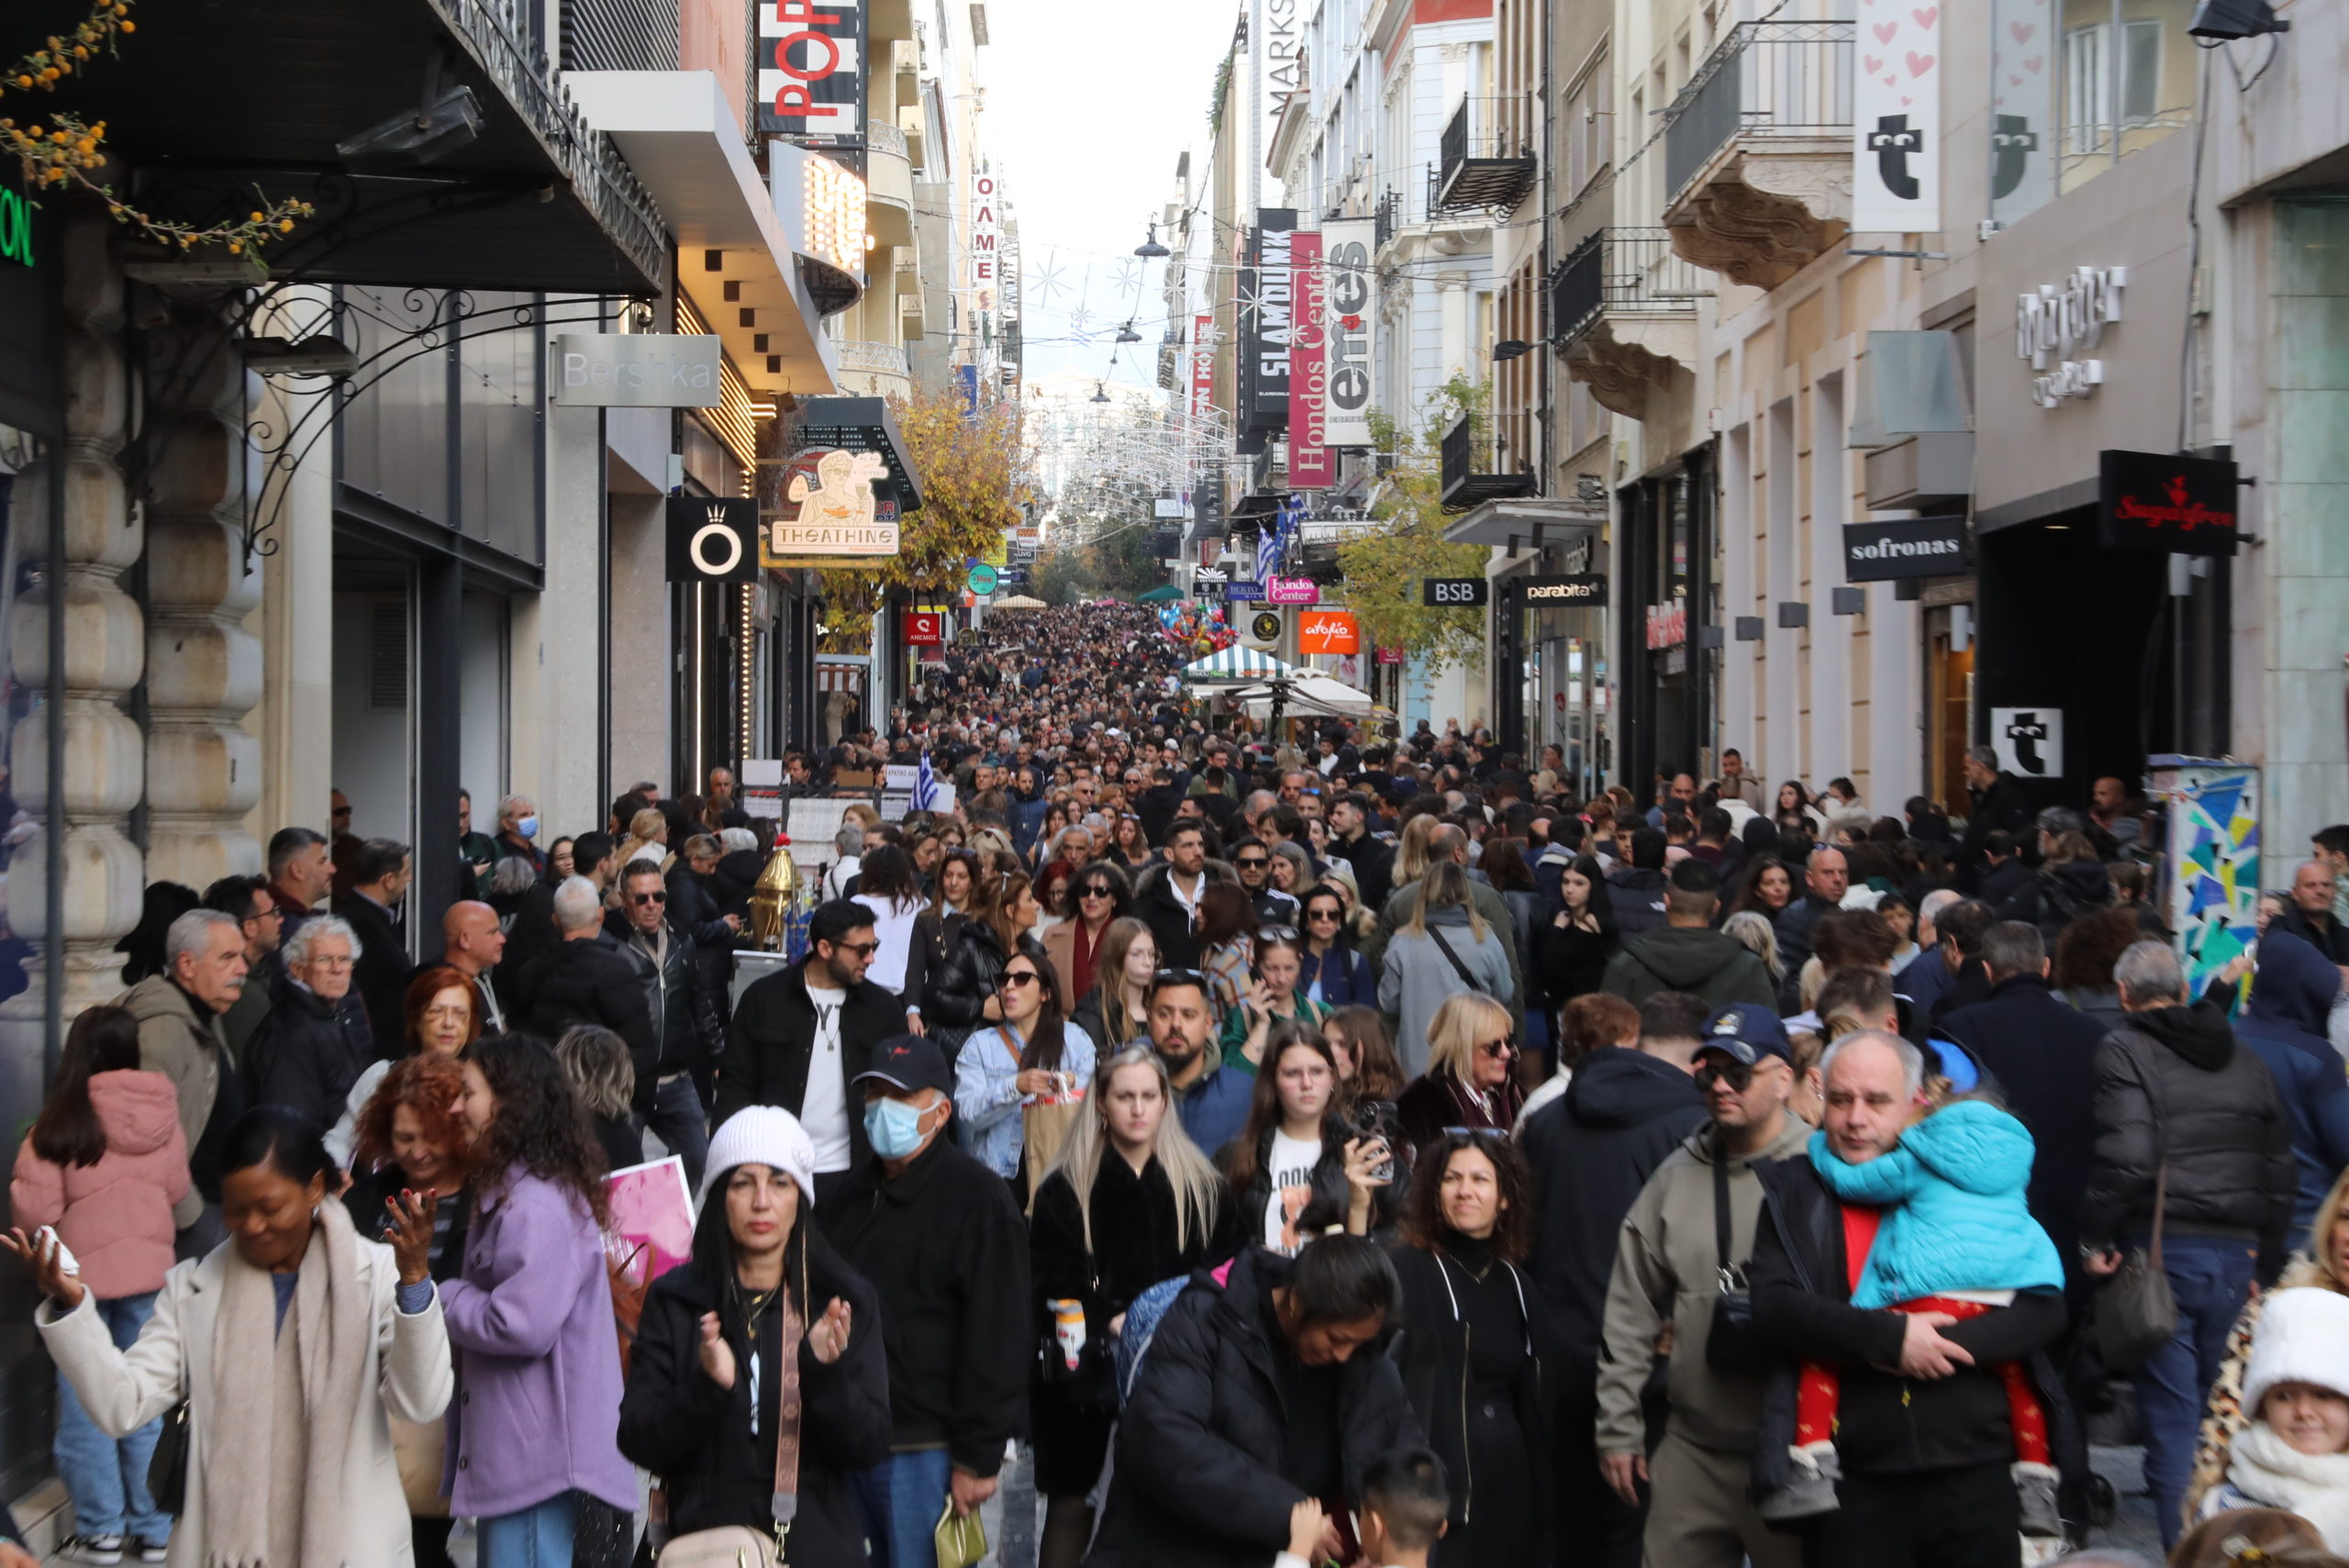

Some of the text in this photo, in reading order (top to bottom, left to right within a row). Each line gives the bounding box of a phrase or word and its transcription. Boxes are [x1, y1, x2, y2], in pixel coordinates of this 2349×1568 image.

[774, 0, 841, 117] POP
[0, 184, 34, 268] ON.
[1260, 229, 1291, 377] SLAMDUNK
[1196, 322, 1212, 380] HOSE
[1298, 253, 1325, 472] Hondos Center
[563, 352, 710, 389] Bershka
[1851, 538, 1960, 561] sofronas
[1272, 590, 1310, 601] Center
[1435, 584, 1475, 602] BSB
[1528, 584, 1590, 599] parabita
[1272, 1166, 1314, 1192] OOK
